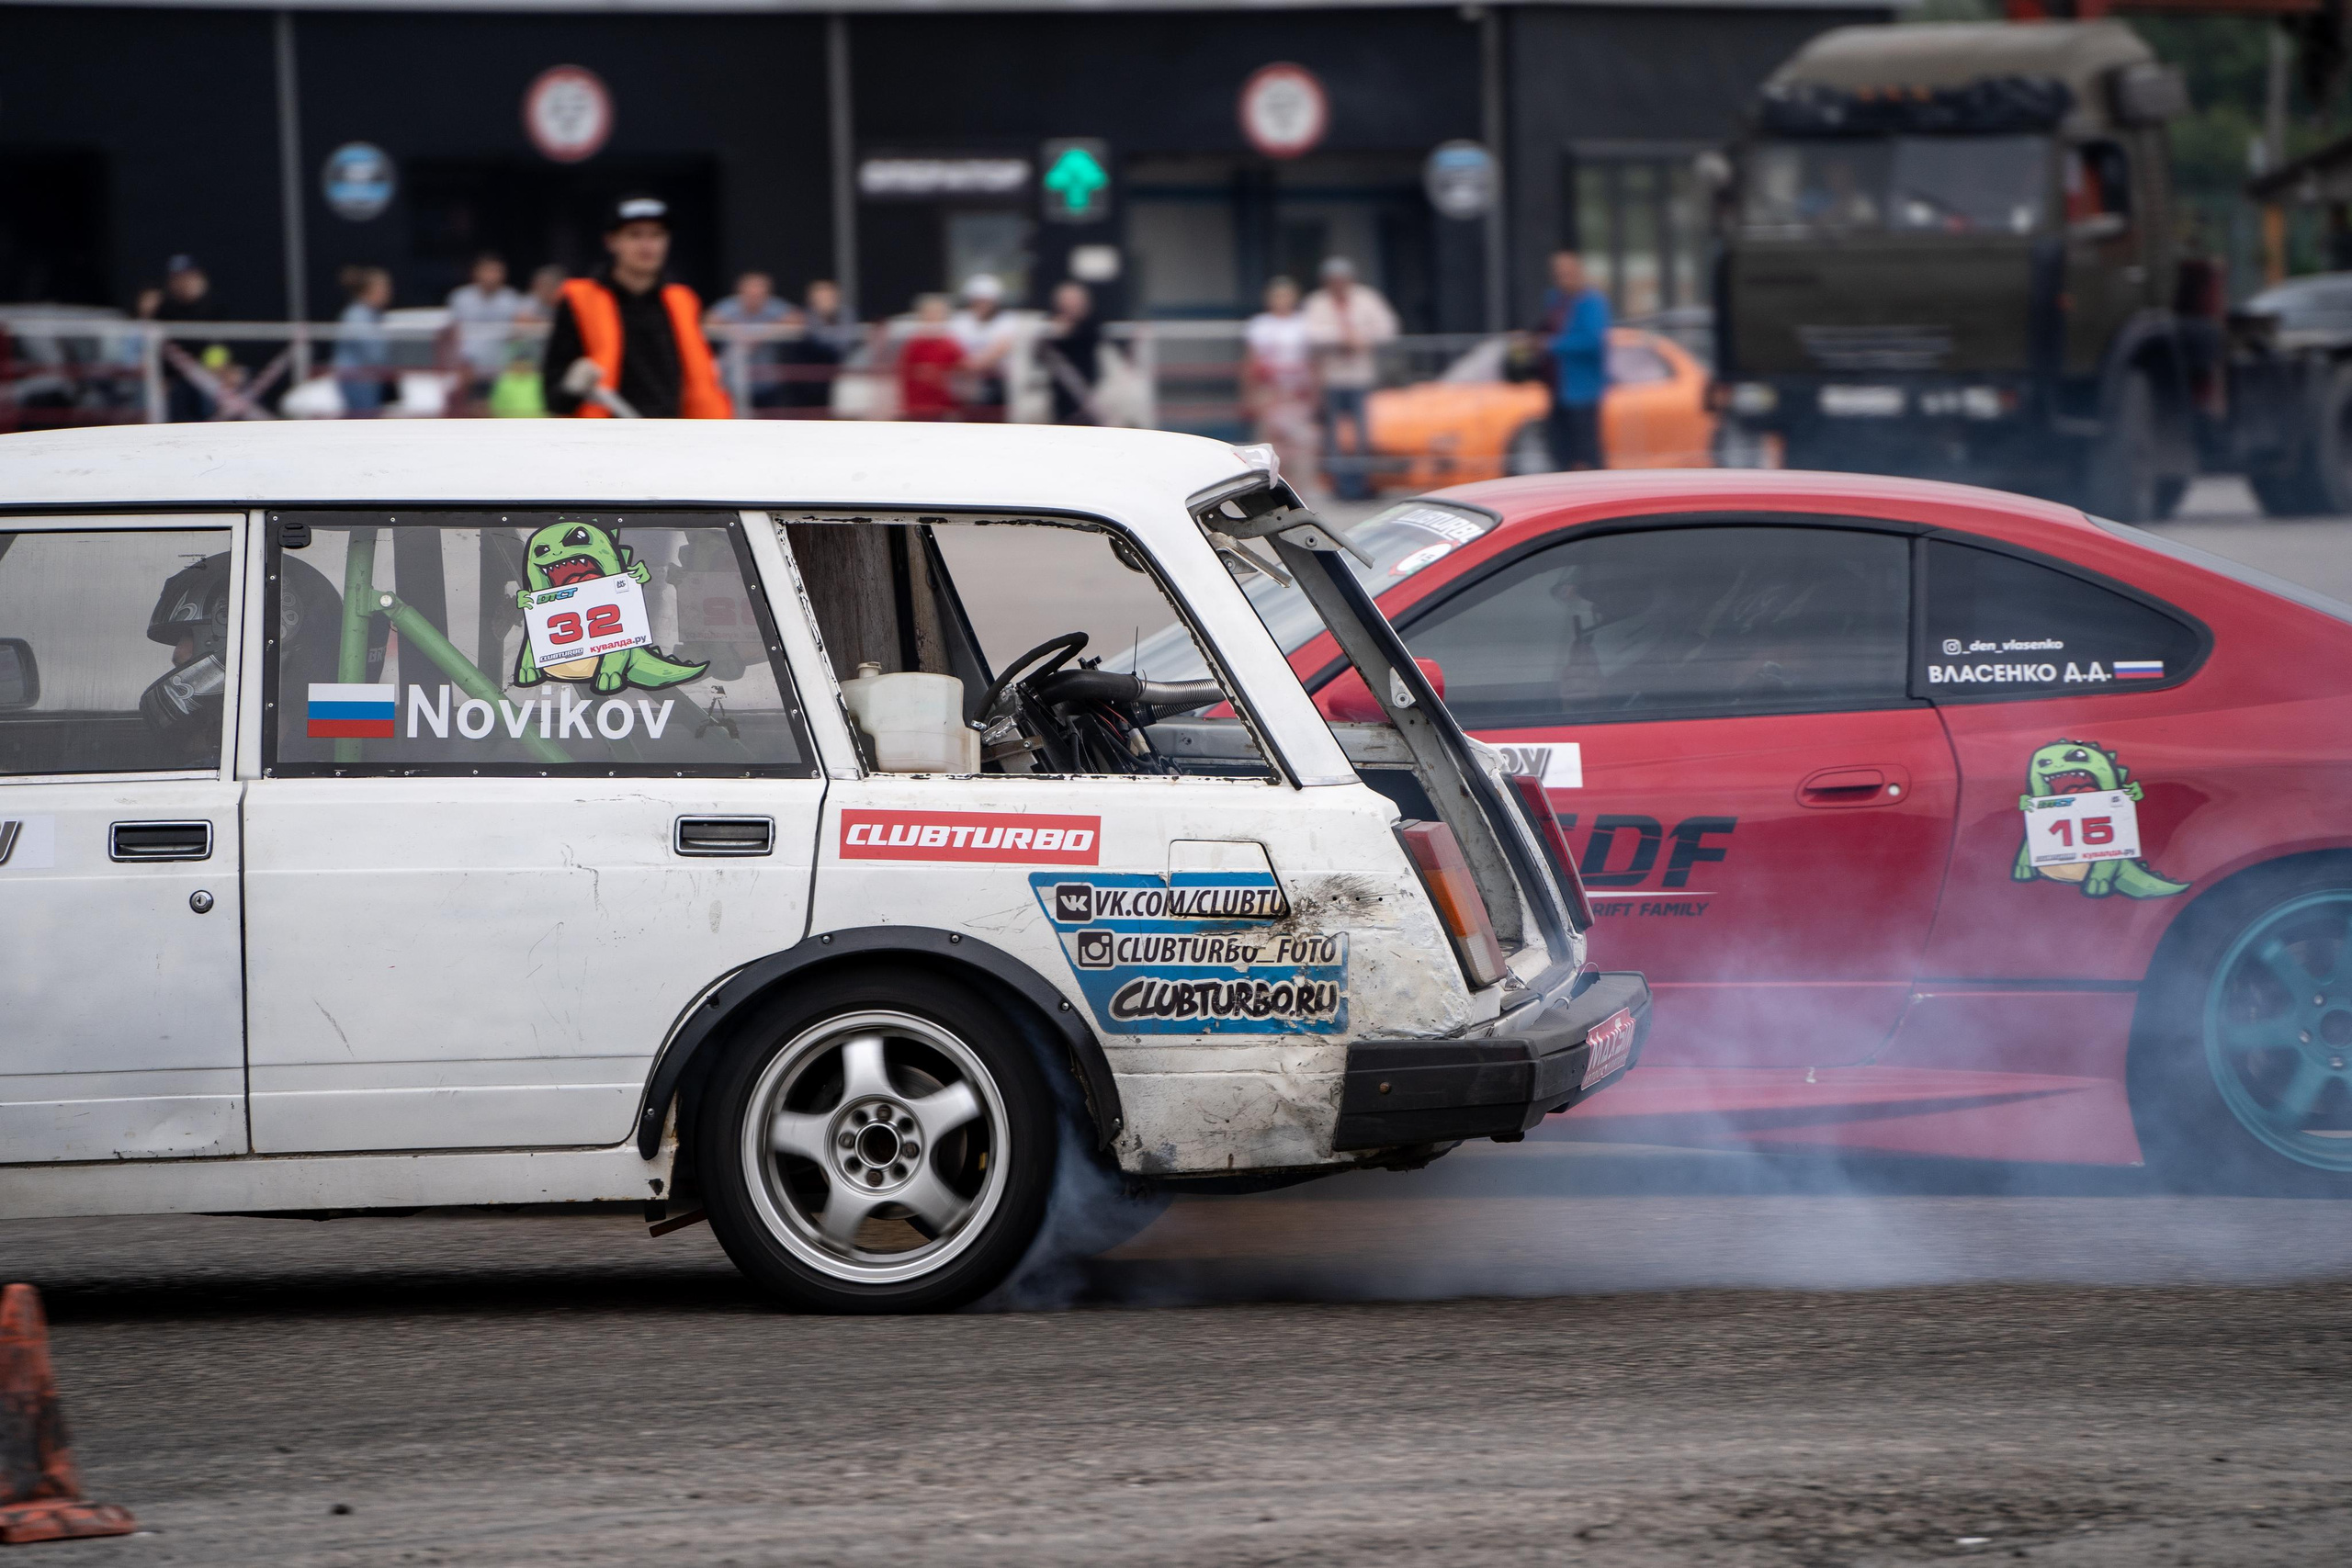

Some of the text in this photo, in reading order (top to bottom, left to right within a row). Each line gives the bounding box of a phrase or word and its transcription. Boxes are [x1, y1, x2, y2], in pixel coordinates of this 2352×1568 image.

[547, 604, 624, 645] 32
[590, 635, 647, 653] кувалда.ру
[1928, 663, 2057, 683] ВЛАСЕНКО
[407, 684, 675, 739] Novikov
[845, 823, 1095, 852] CLUBTURBO
[2048, 816, 2115, 847] 15
[1555, 813, 1739, 888] DF
[1592, 902, 1710, 917] RIFT FAMILY
